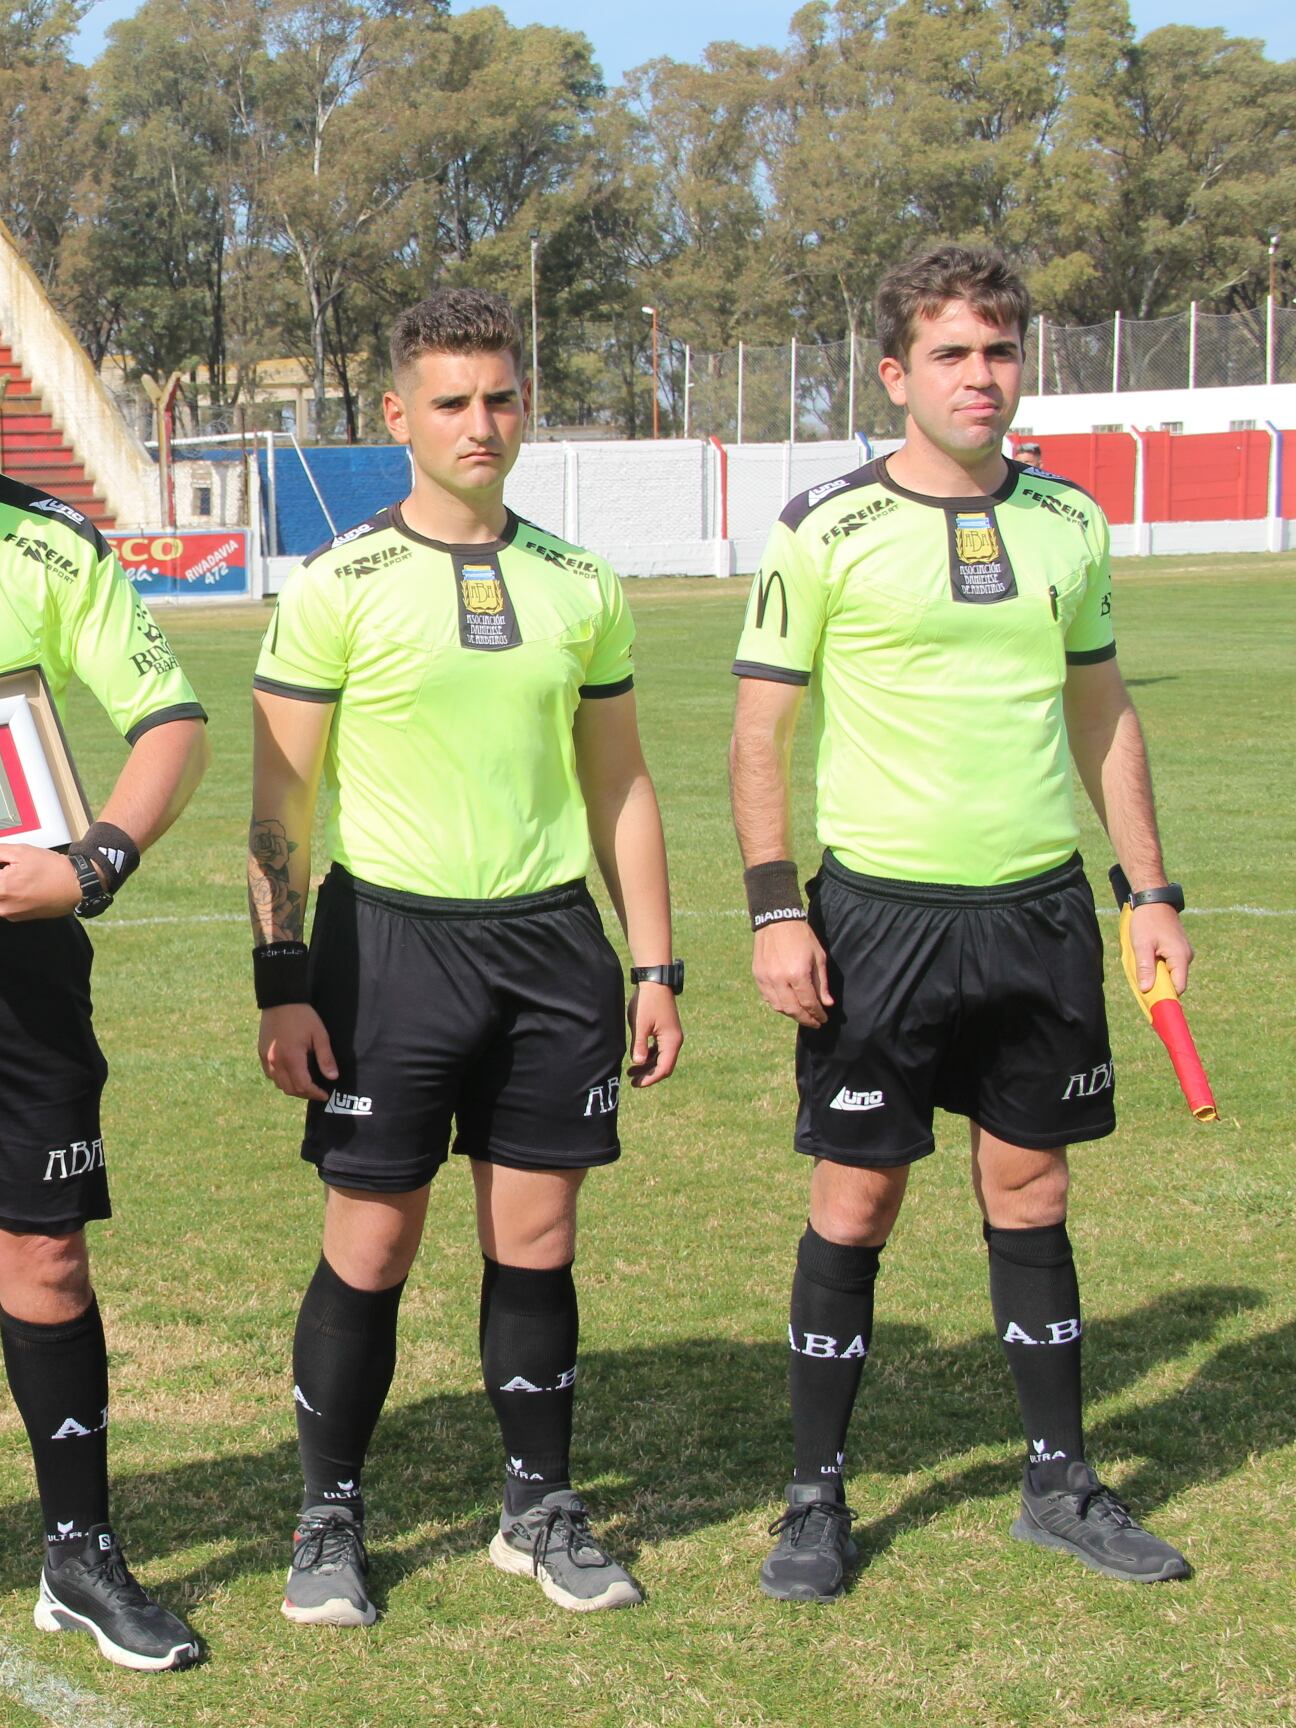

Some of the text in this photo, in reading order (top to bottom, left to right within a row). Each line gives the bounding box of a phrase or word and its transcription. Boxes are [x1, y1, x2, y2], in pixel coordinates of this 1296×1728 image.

[185, 540, 240, 583] RIVADAVIA
[382, 551, 413, 569] SPORT
[46, 563, 74, 585] SPORT
[205, 561, 229, 584] 472
